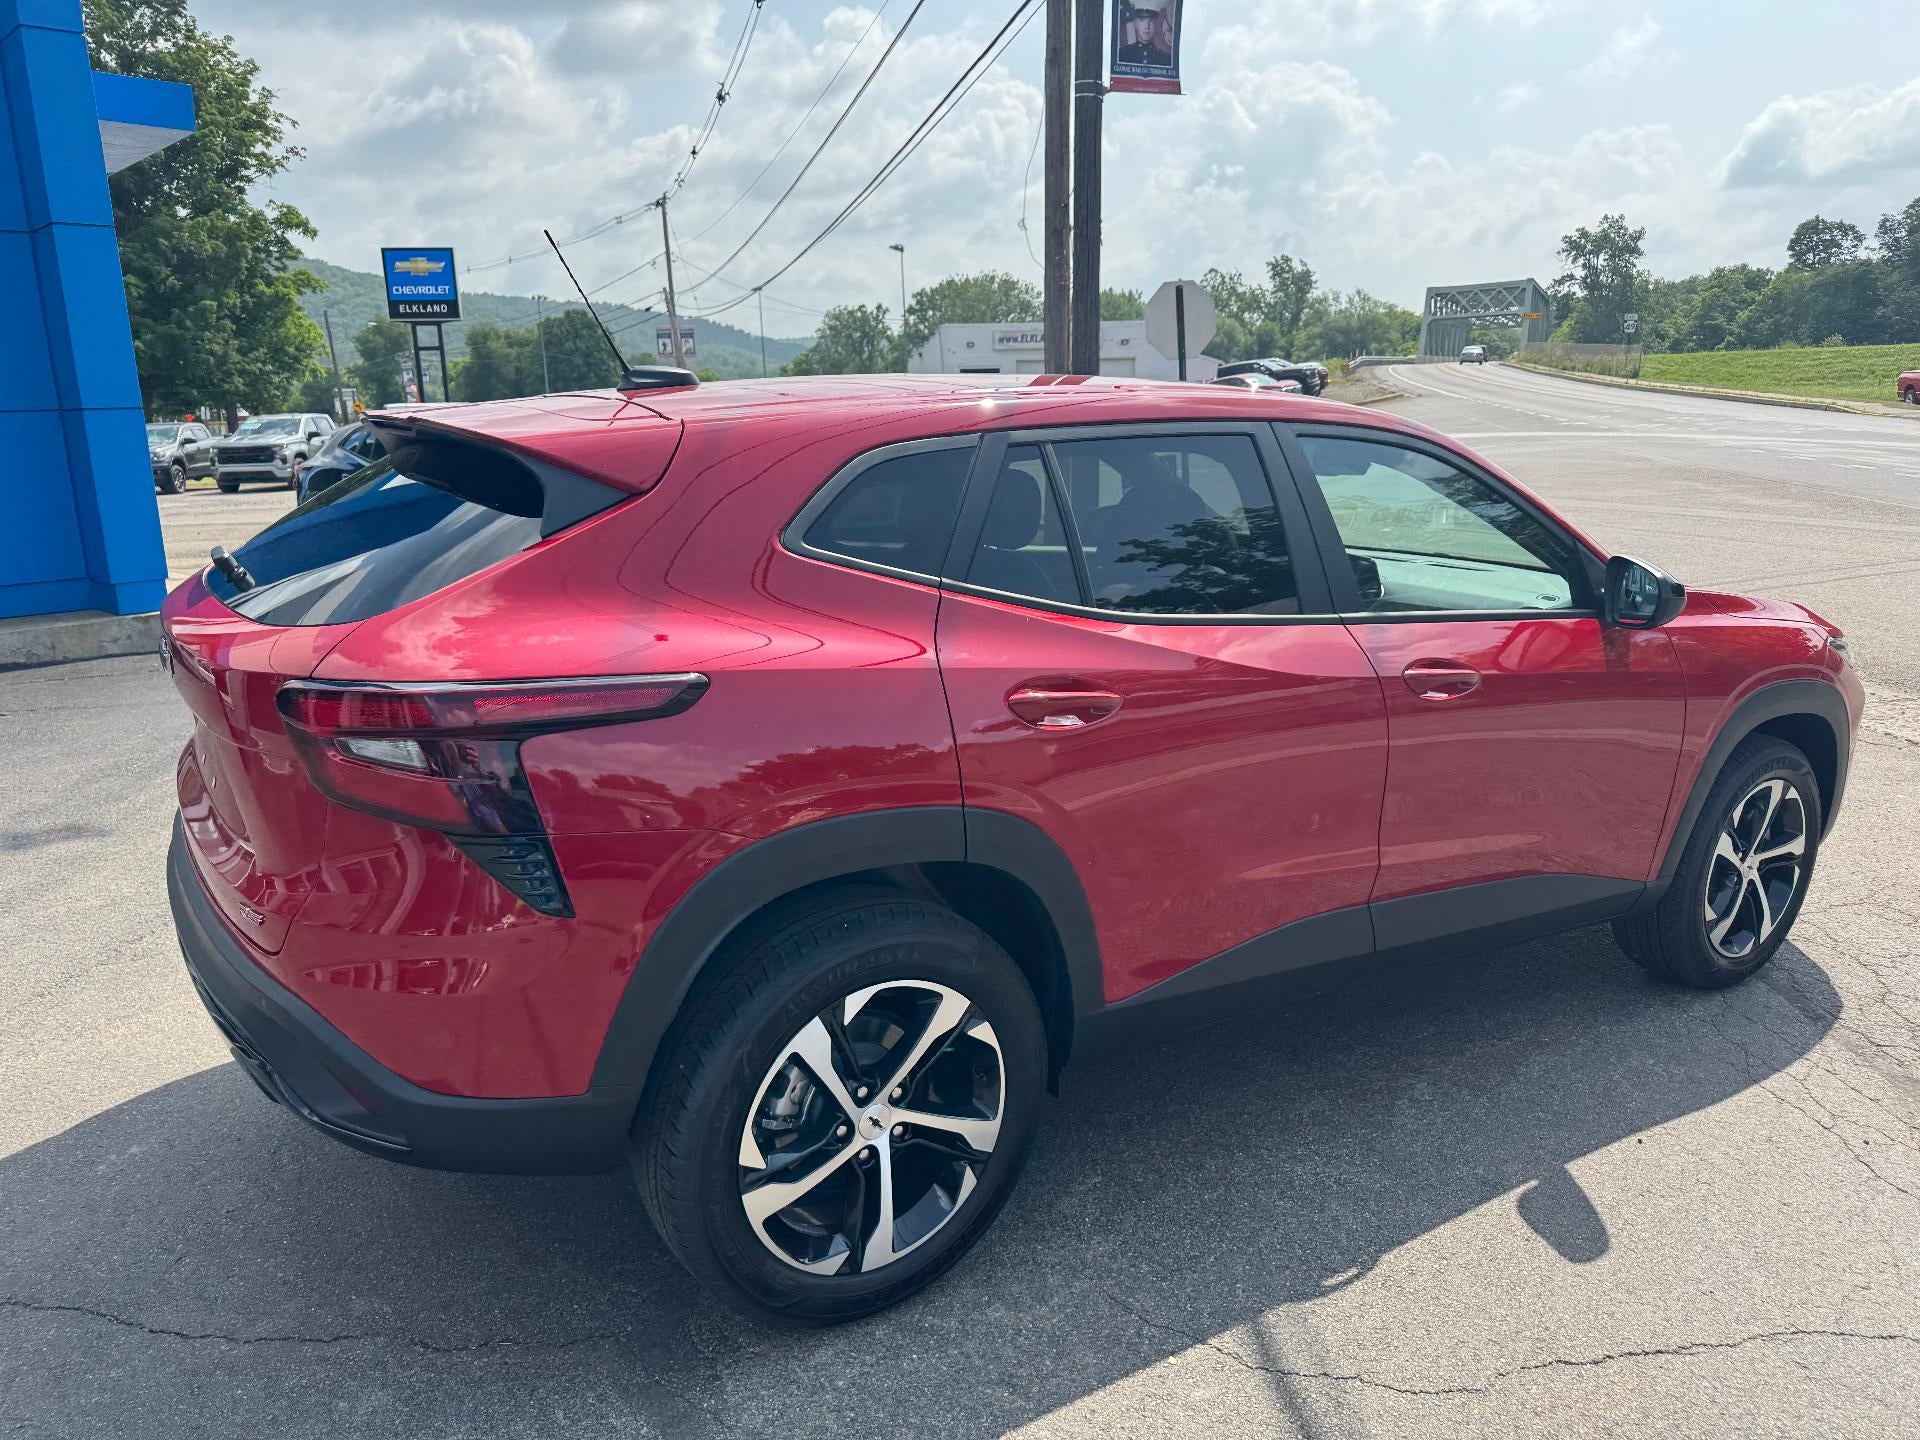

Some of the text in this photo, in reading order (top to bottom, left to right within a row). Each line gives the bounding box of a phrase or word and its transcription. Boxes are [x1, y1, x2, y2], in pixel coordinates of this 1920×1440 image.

[392, 285, 450, 295] CHEVROLET
[399, 304, 448, 313] ELKLAND
[1625, 323, 1636, 331] 49
